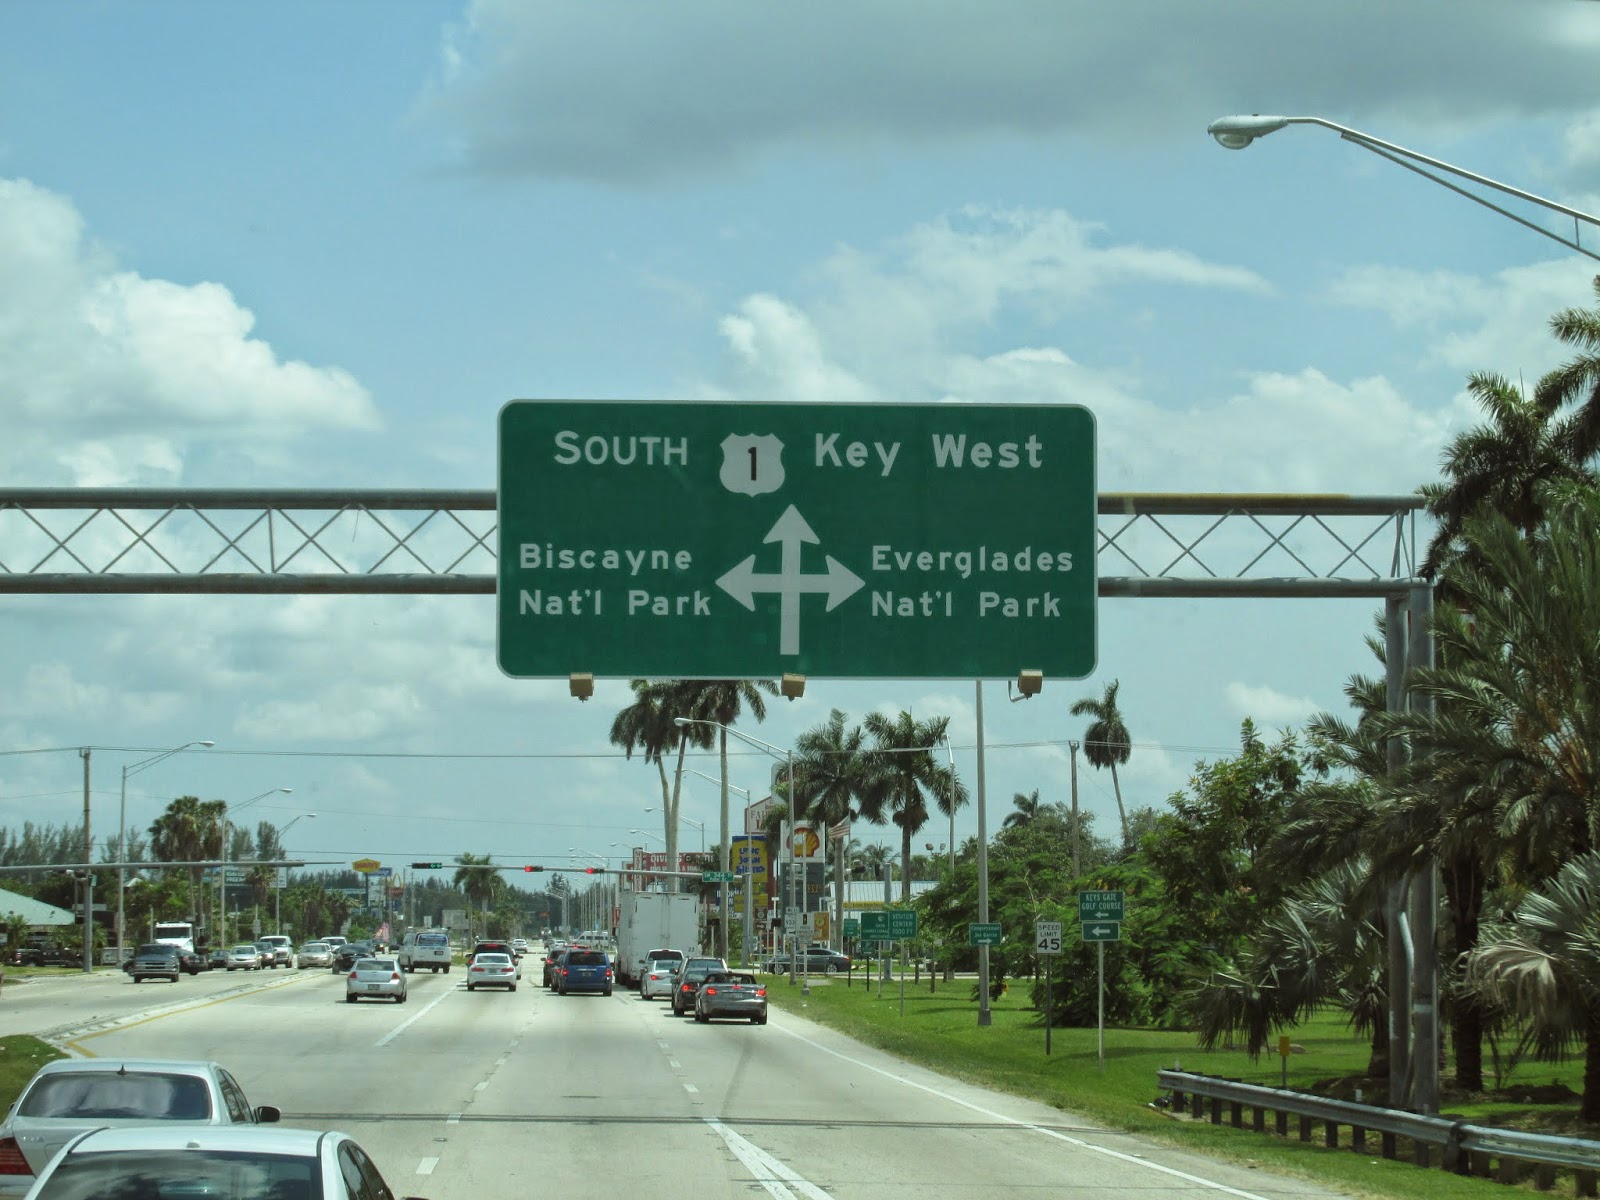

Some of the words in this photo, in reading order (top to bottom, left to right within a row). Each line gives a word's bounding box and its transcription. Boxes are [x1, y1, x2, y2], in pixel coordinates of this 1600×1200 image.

[553, 430, 688, 465] SOUTH
[814, 433, 902, 477] Key
[931, 434, 1043, 469] West
[746, 446, 758, 482] 1
[519, 543, 693, 576] Biscayne
[872, 545, 1074, 579] Everglades
[519, 589, 602, 616] Nat'l
[628, 590, 711, 616] Park
[872, 591, 953, 617] Nat'l
[979, 591, 1061, 618] Park
[1081, 902, 1096, 910] GOLF
[1098, 902, 1121, 910] COURSE
[1085, 893, 1100, 901] KEYS
[1102, 893, 1117, 901] GATE
[1038, 938, 1060, 951] 45
